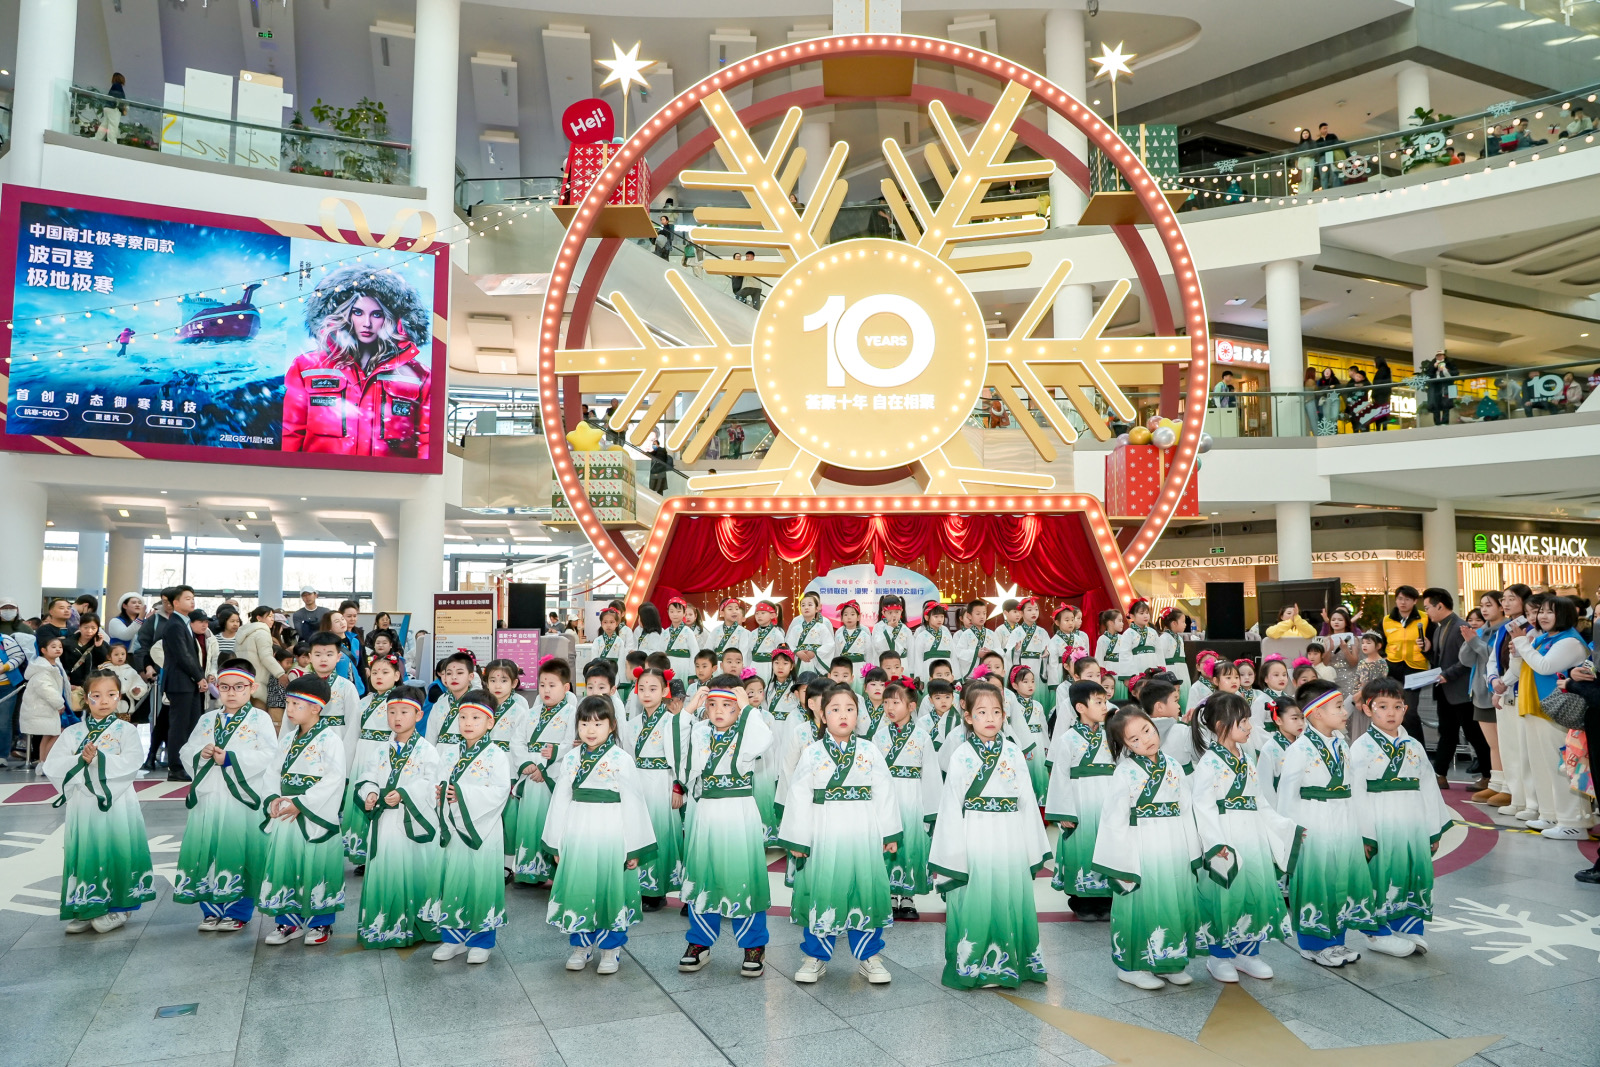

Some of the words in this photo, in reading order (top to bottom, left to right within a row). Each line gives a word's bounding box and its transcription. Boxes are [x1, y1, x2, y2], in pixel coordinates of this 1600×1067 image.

[570, 107, 606, 136] Hej!
[29, 222, 175, 254] 中国南北极考察同款
[28, 244, 94, 270] 波司登
[26, 267, 114, 295] 极地极寒
[803, 294, 936, 388] 10
[864, 335, 908, 346] YEARS
[1527, 374, 1565, 397] 10
[16, 388, 197, 414] 首创动态御寒科技
[499, 403, 536, 411] BOLON
[873, 393, 936, 410] 自在相聚
[1344, 551, 1379, 560] SODA
[1491, 533, 1540, 555] SHAKE
[1540, 536, 1589, 558] SHACK
[1160, 558, 1200, 568] FROZEN
[1204, 556, 1253, 567] CUSTARD
[1466, 553, 1500, 561] CUSTARD
[1525, 555, 1550, 563] SHAKES
